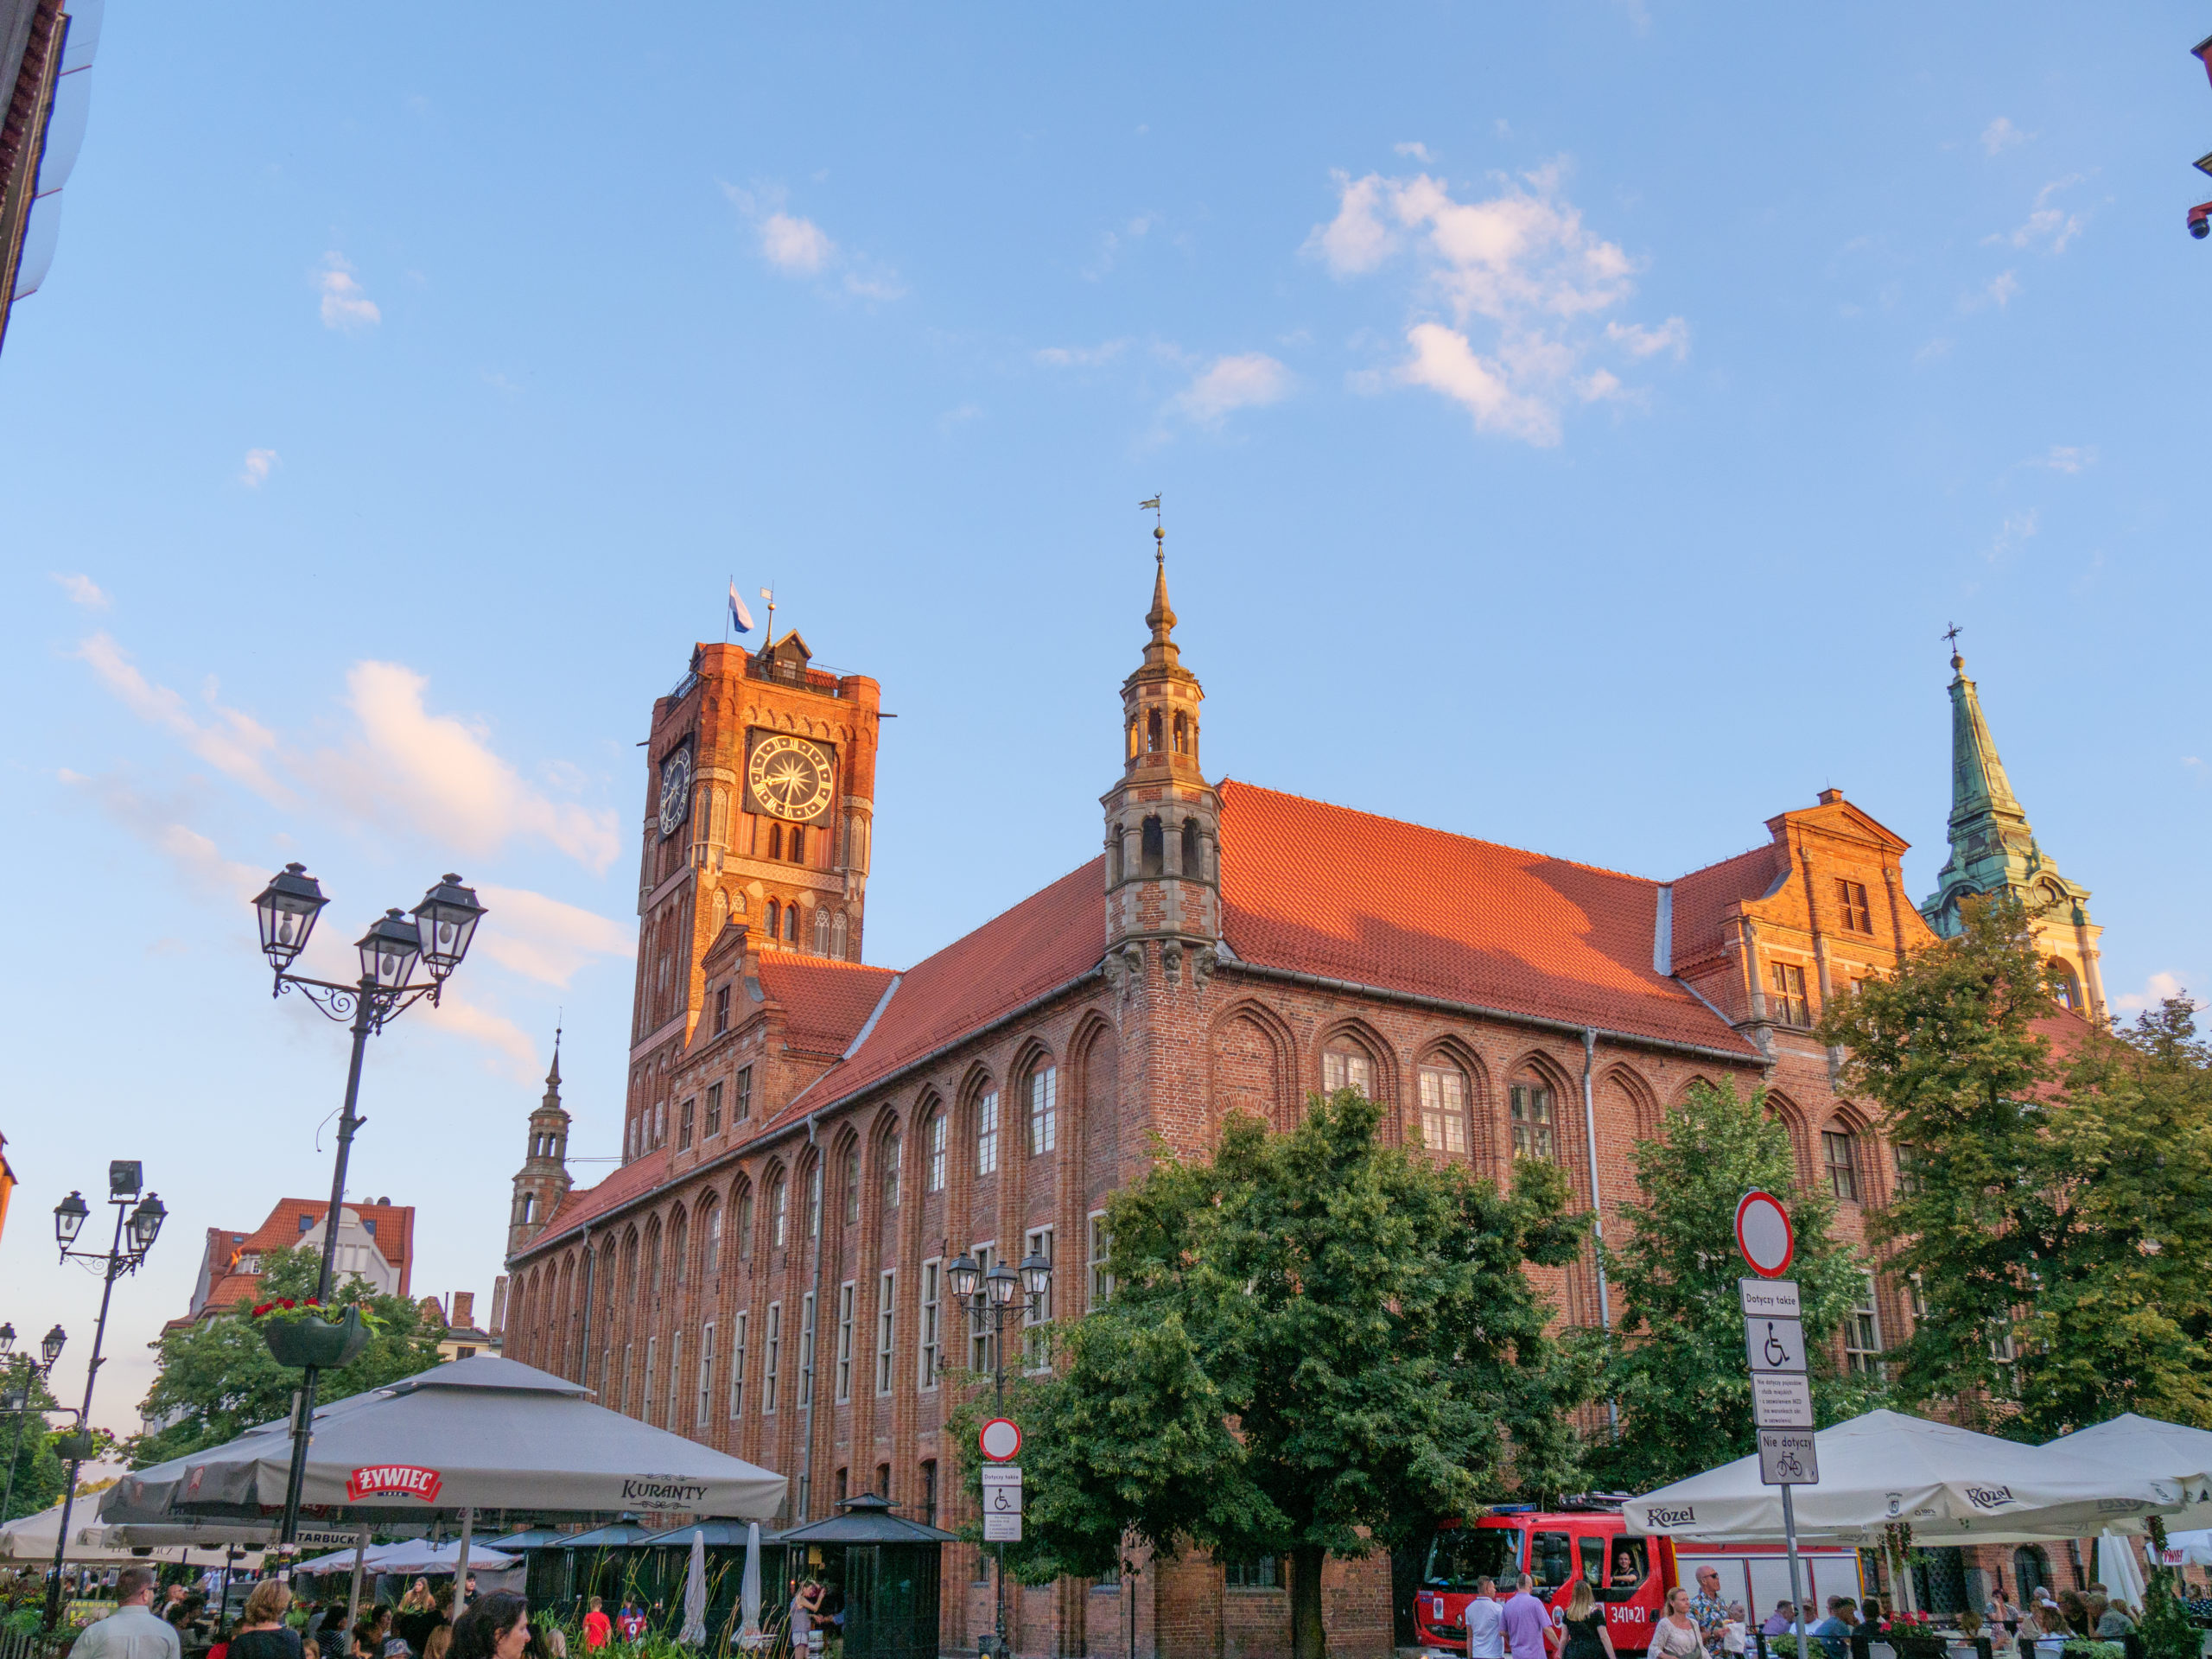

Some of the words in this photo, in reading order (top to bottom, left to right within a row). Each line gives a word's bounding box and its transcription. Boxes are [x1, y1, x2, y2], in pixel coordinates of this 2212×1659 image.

[1746, 1294, 1774, 1306] Dotyczy
[1777, 1295, 1796, 1305] także
[1764, 1435, 1777, 1447] Nie
[1782, 1435, 1812, 1451] dotyczy
[359, 1468, 433, 1491] ŻYWIEC
[620, 1479, 708, 1501] KURANTY
[1964, 1485, 2016, 1509] Kozel
[1646, 1506, 1696, 1528] Kozel
[296, 1533, 359, 1545] TARBUCK
